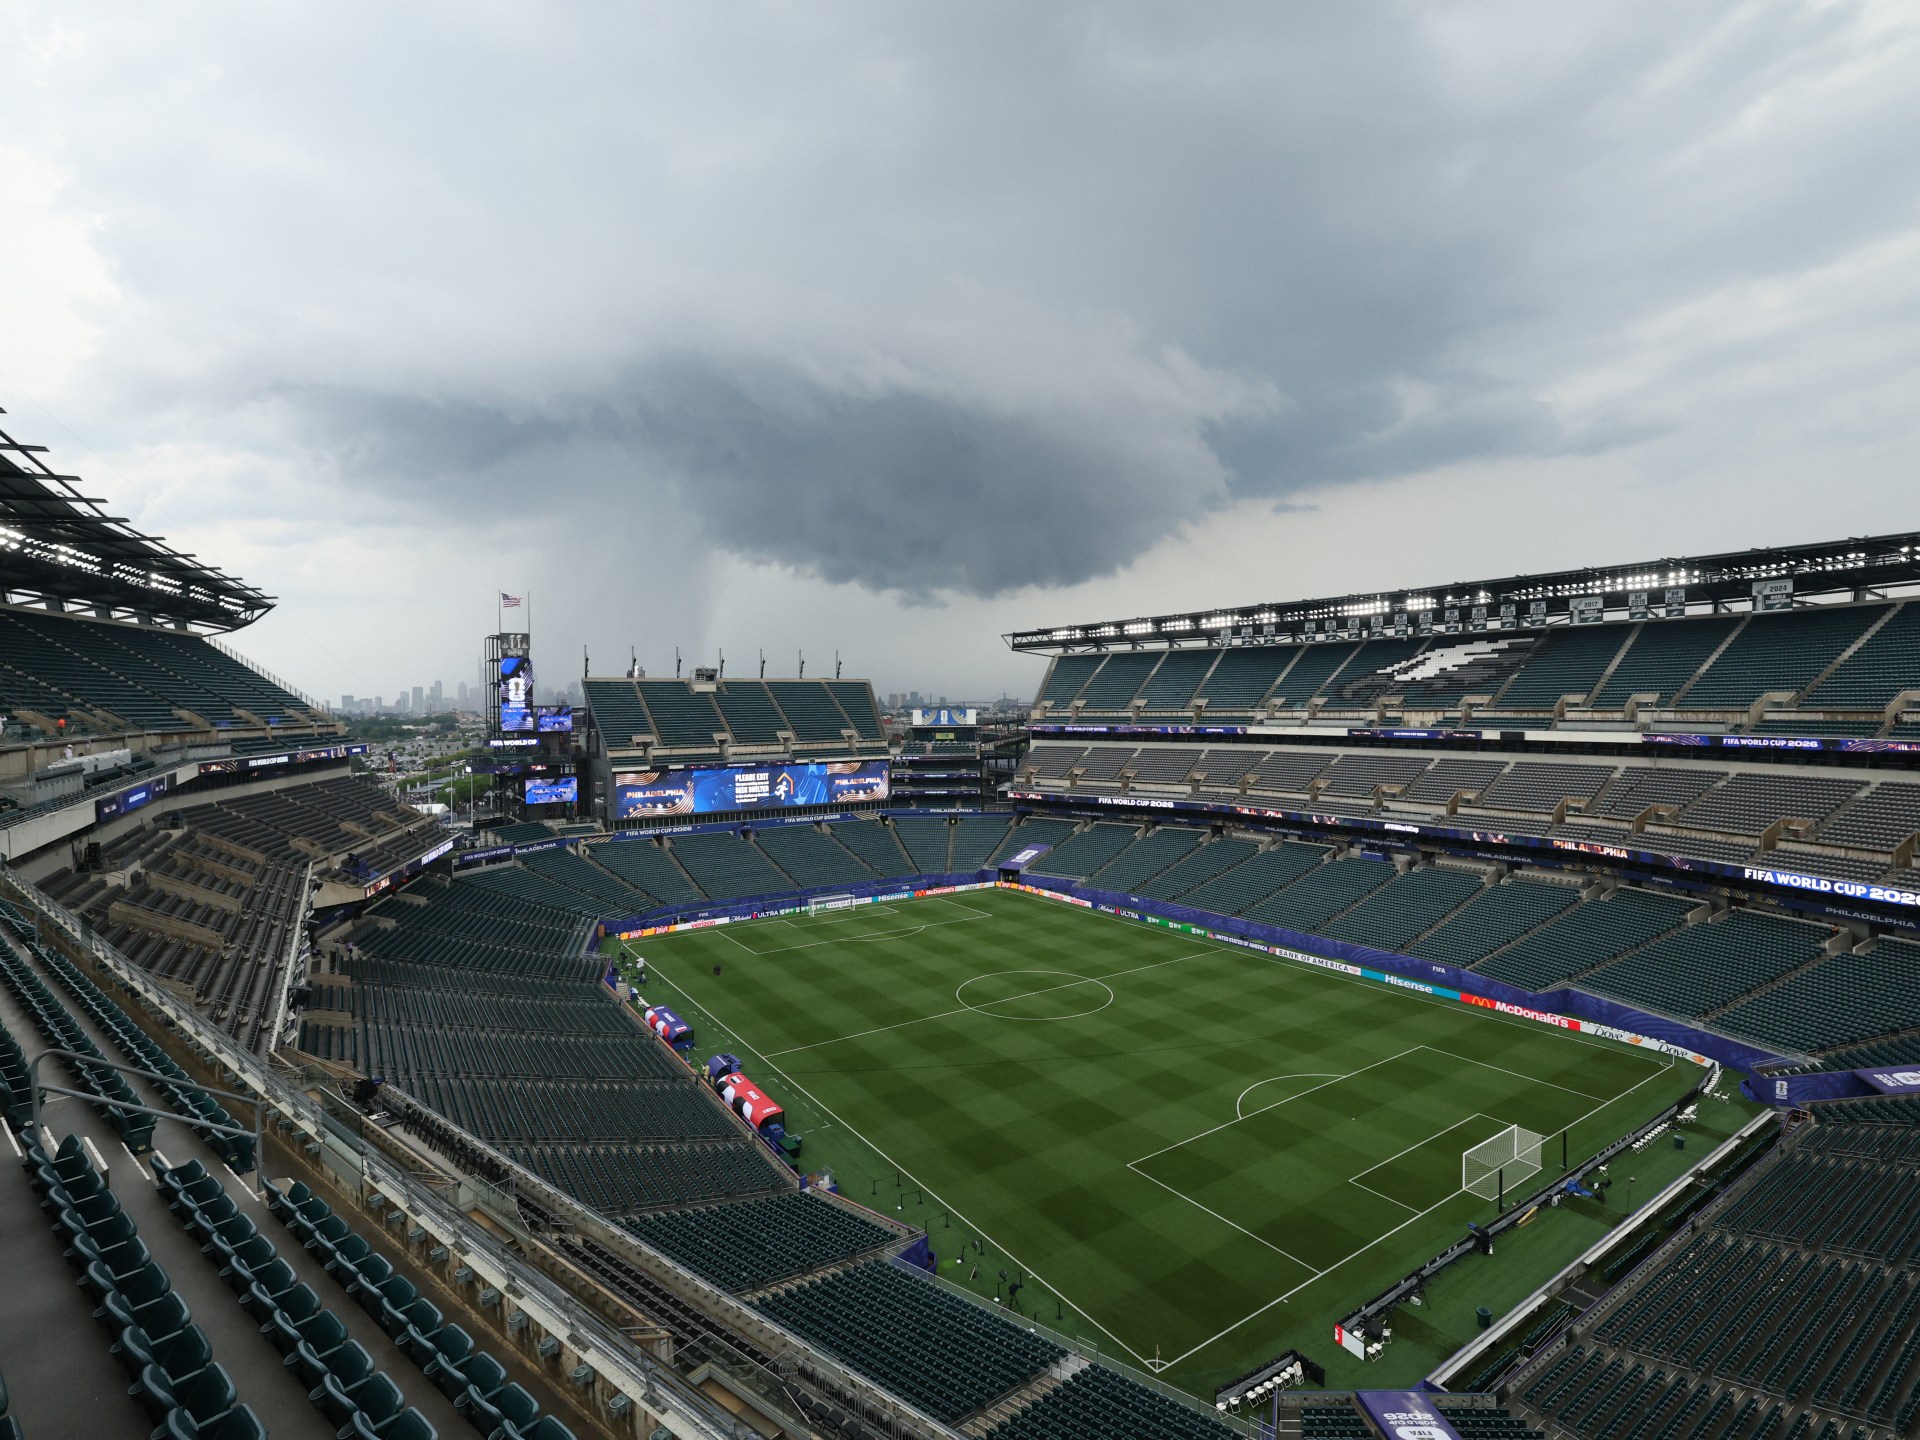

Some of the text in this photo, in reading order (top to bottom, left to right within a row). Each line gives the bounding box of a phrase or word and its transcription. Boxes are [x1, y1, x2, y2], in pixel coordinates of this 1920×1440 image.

[735, 773, 770, 782] PLEASE EXIT
[835, 778, 881, 786] PHILADELPHIA
[626, 789, 684, 798] PHILADELPHIA
[1236, 807, 1282, 818] PHILAELPHIA
[1265, 826, 1302, 834] PHILADELPHIA
[515, 843, 557, 854] PHILADELPHIA
[1553, 840, 1628, 858] PHILADELPHIA
[1477, 852, 1532, 863] PHILADELPHIA
[926, 886, 955, 896] McDonald's
[1744, 868, 1920, 906] FIFA WORLD CUP 202
[878, 892, 908, 902] Hisense
[1070, 898, 1086, 906] verizon
[1120, 910, 1140, 920] ULTRA
[1825, 907, 1916, 928] PHILADELPHIA
[691, 920, 716, 928] verizon
[1214, 934, 1228, 942] UNITED
[1228, 937, 1243, 946] STATES
[1248, 942, 1268, 952] AMERICA
[1278, 950, 1299, 960] BANK
[1312, 958, 1348, 972] AMERICA
[1384, 974, 1433, 994] Hisense
[1495, 1001, 1568, 1028] McDonald's
[1594, 1026, 1623, 1041] Dove
[1658, 1042, 1688, 1058] Dove
[1383, 1412, 1434, 1420] 2026
